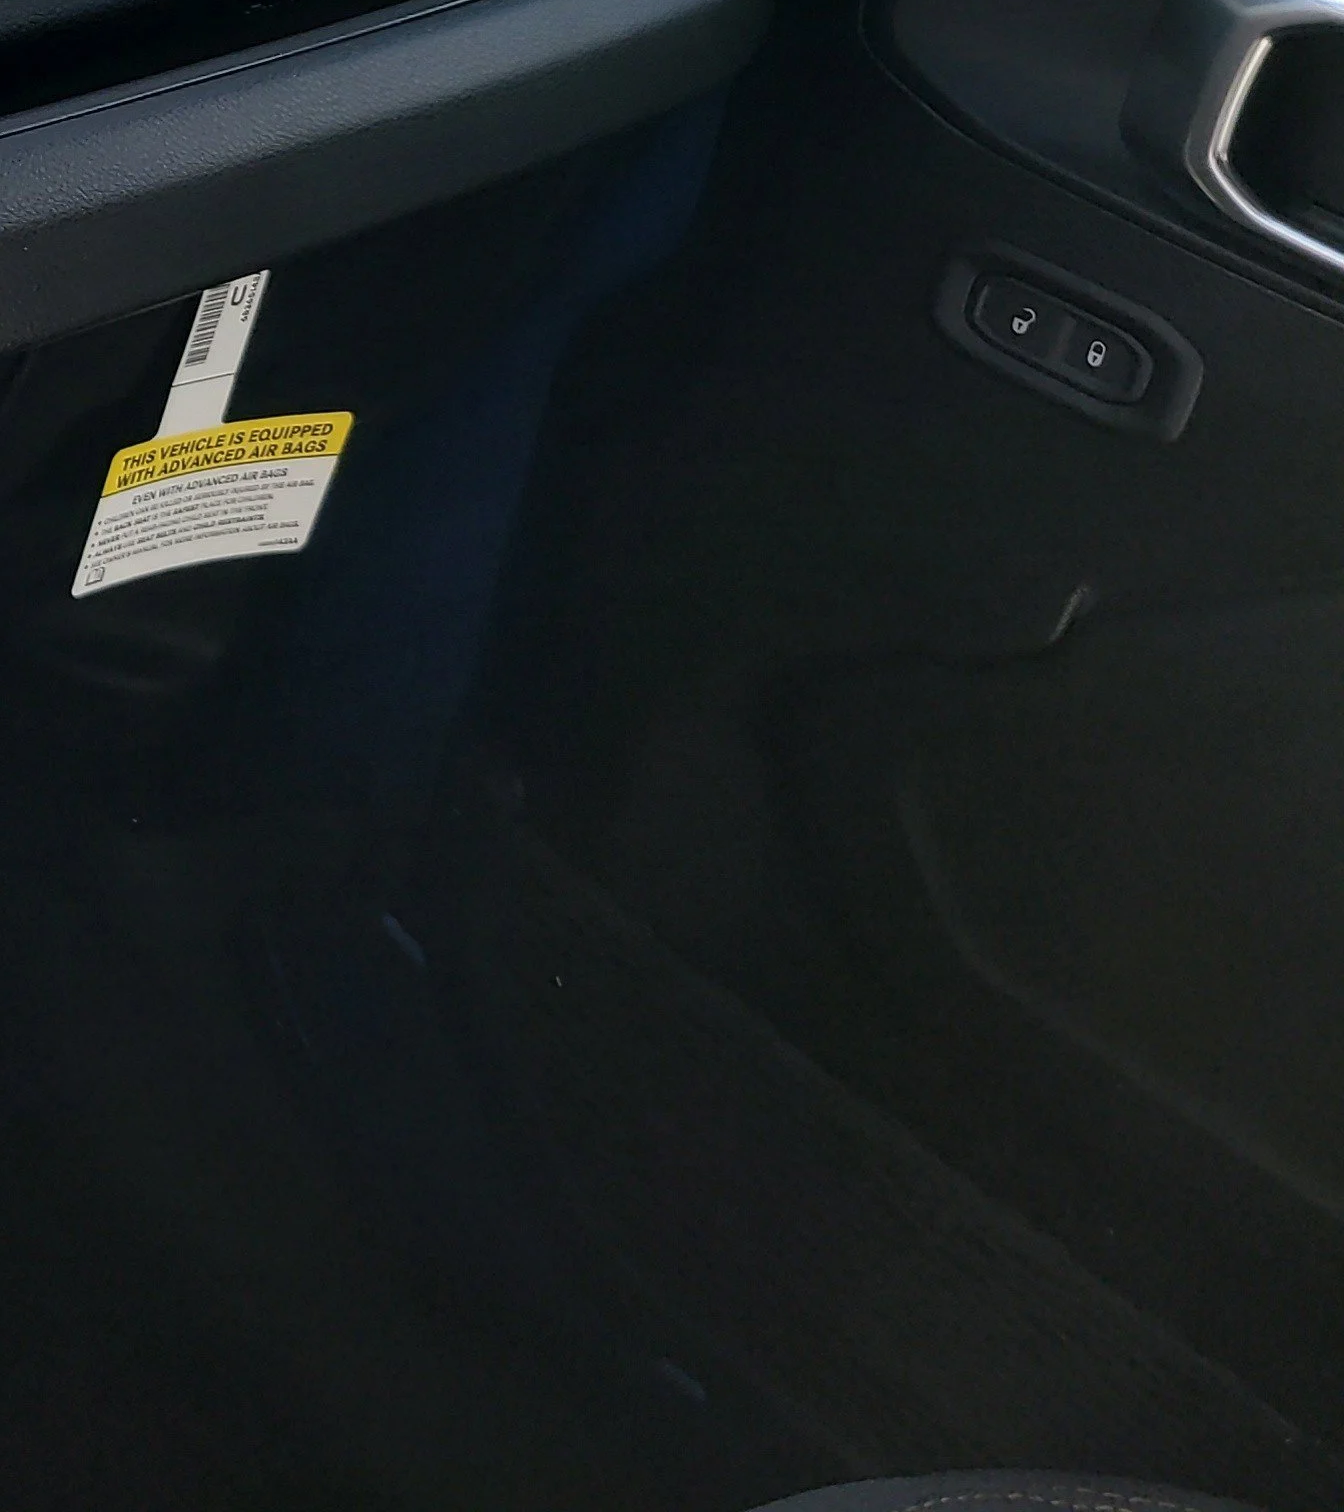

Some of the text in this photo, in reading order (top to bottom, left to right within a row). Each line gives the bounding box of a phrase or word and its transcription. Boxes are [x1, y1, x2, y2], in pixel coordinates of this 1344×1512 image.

[116, 440, 329, 489] WITH ADVANCED AIR BAGS
[123, 423, 334, 471] THIS VEHICLE IS EQUIPPED
